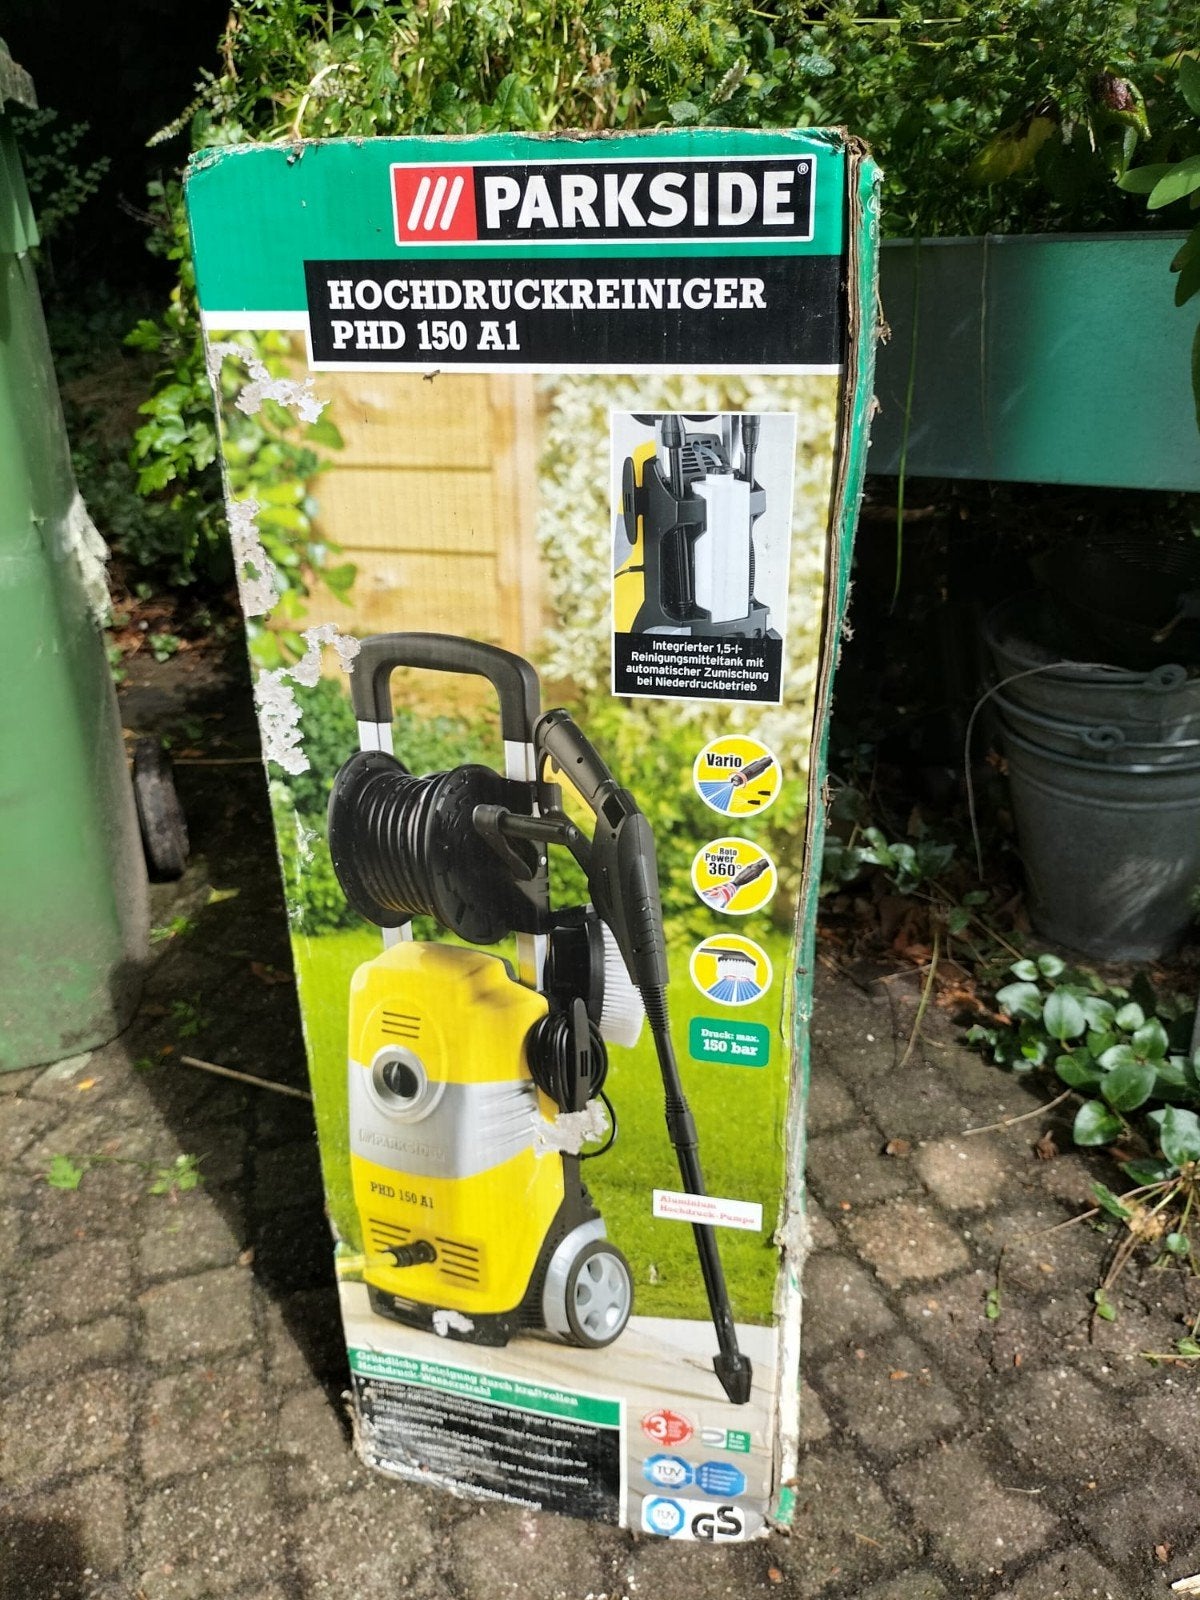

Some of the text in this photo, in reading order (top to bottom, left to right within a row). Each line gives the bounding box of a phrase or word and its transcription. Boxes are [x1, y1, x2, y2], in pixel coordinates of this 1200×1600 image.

[484, 168, 795, 230] PARKSIDE
[327, 277, 766, 311] HOCHDRUCKREINIGER
[333, 321, 521, 351] PHD 150 A1
[652, 640, 714, 654] Integrierter
[631, 651, 764, 668] Reinigungsmitteltank mit
[626, 664, 769, 682] automatischer Zumischung
[637, 676, 757, 691] bei Niederdruckbetrieb
[707, 753, 742, 768] Vario
[705, 852, 734, 863] Power
[701, 1028, 760, 1043] Druck: max.
[703, 1038, 759, 1056] 150 bar
[370, 1181, 434, 1209] PHD 150 A1
[660, 1195, 717, 1210] Aluminium
[420, 1362, 478, 1386] Reinigung
[479, 1375, 513, 1393] durch
[514, 1383, 578, 1406] kraftvollen
[649, 1415, 667, 1438] 3
[691, 1505, 742, 1541] GS
